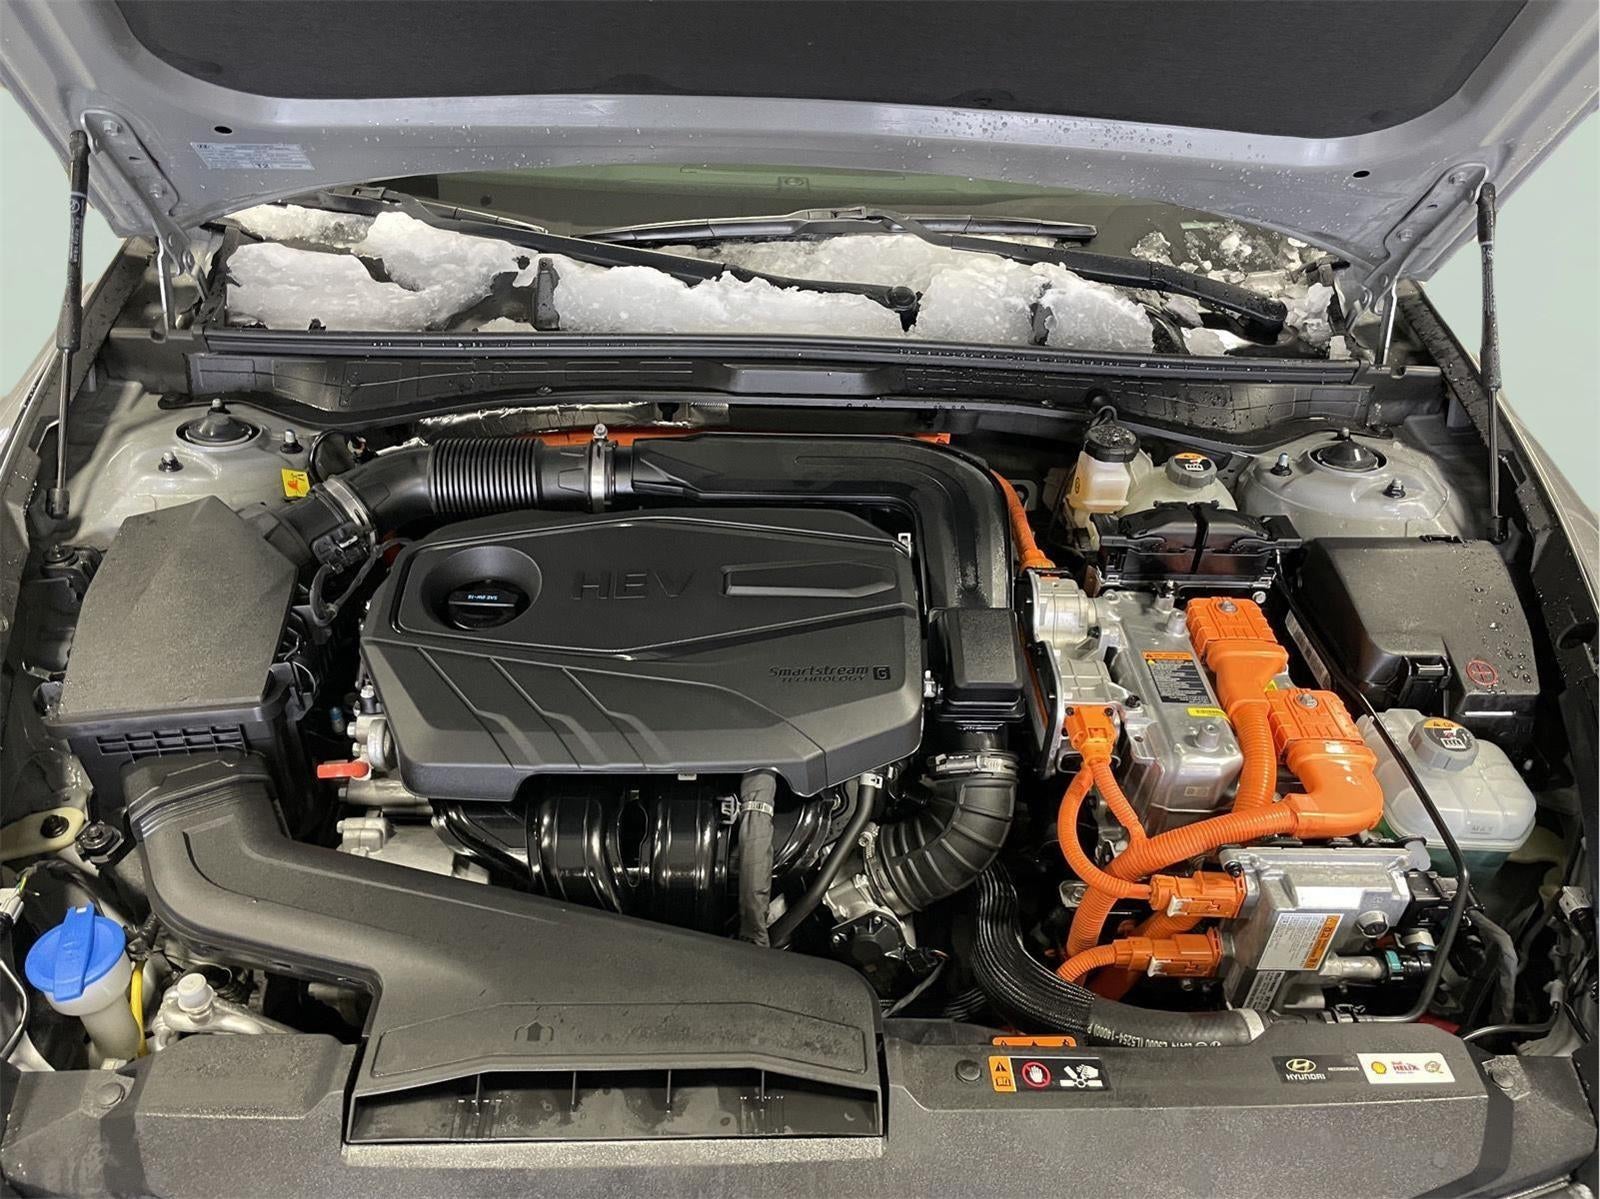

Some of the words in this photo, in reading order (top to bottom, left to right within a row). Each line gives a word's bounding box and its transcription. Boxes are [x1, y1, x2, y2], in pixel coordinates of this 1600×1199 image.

[573, 572, 695, 600] HEV
[769, 664, 869, 677] Smartstream
[1285, 1073, 1327, 1081] HYUNDAI
